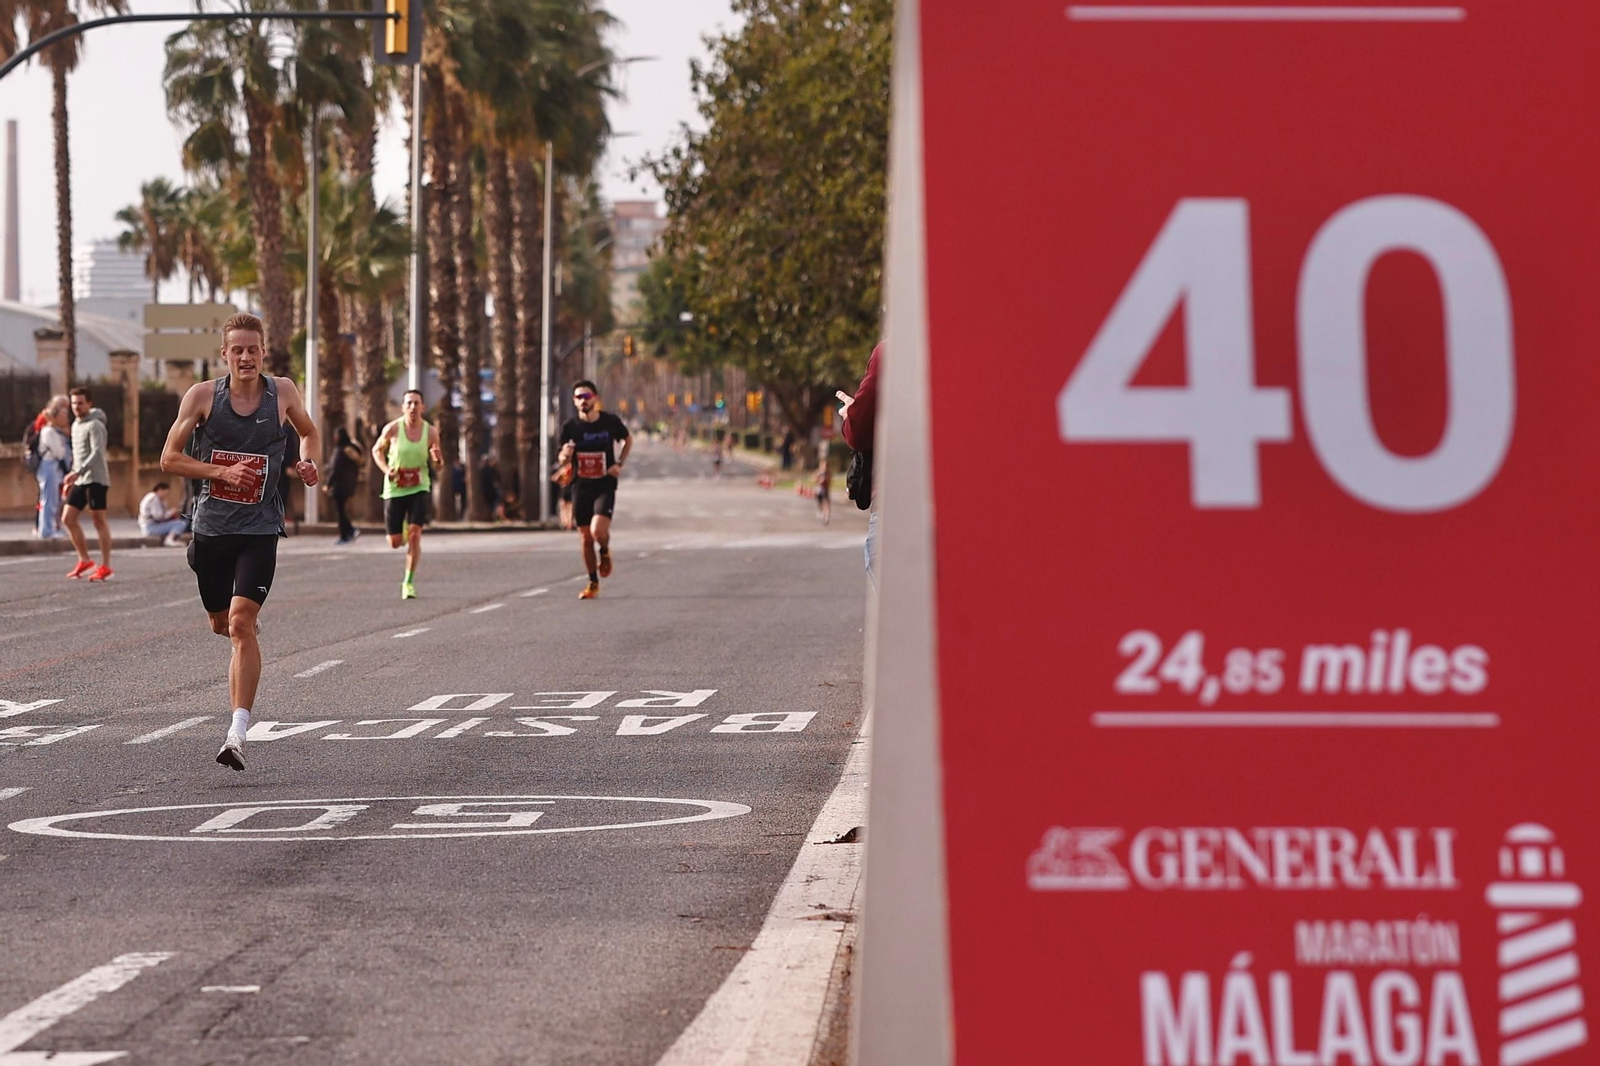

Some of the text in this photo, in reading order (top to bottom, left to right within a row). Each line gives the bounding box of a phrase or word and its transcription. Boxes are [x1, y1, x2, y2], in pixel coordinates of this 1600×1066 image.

[1057, 194, 1516, 512] 40
[1115, 629, 1489, 704] 24,85 miles
[406, 689, 718, 711] RED
[190, 801, 556, 833] 50
[1130, 828, 1458, 889] GENERALI
[1295, 913, 1461, 965] MARATÓN
[1140, 951, 1481, 1066] MÁLAGA
